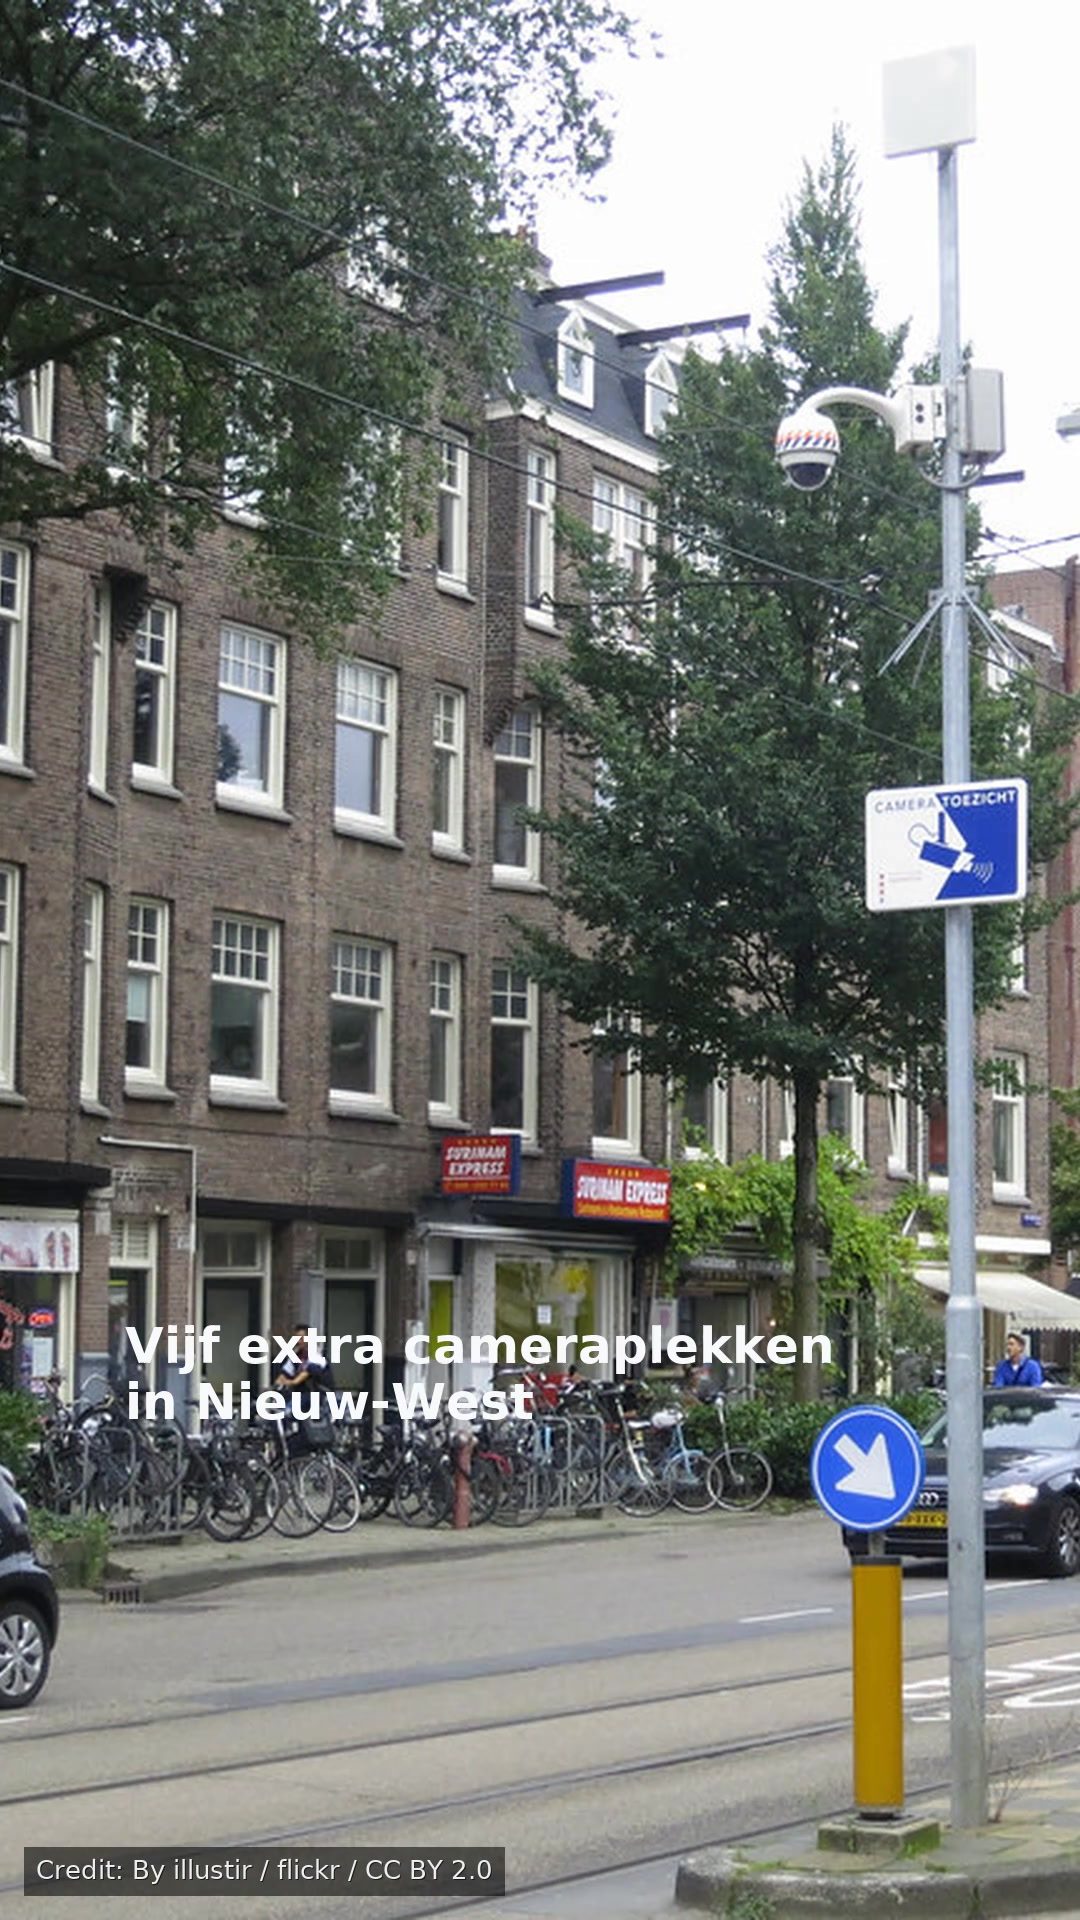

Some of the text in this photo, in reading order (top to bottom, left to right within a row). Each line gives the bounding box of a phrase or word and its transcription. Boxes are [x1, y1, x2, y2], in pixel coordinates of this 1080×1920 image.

[874, 789, 1017, 814] CAMERA TOEZICHT
[445, 1145, 507, 1160] SURINAM
[449, 1162, 505, 1176] EXPRESS
[577, 1175, 669, 1205] SURINAM EXPRESS
